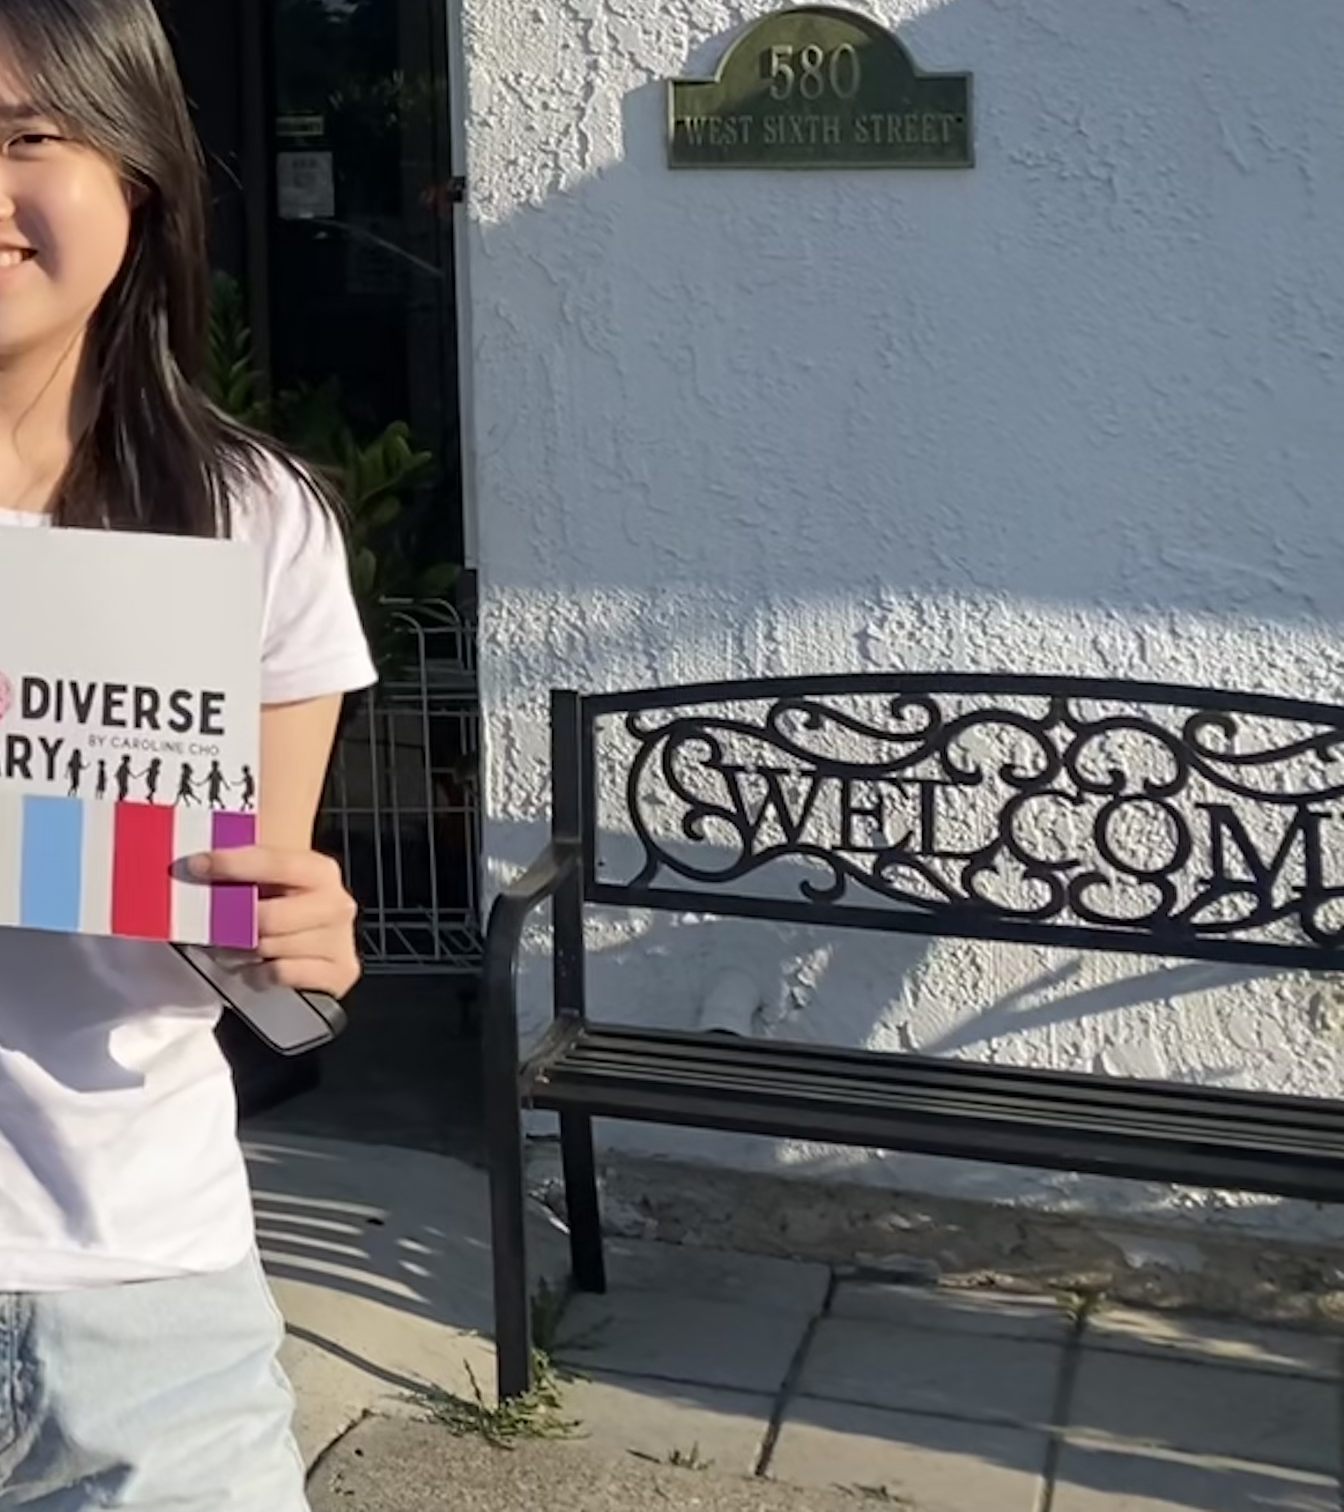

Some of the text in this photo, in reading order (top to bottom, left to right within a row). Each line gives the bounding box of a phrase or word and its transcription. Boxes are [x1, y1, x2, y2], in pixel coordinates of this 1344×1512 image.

[769, 44, 860, 100] 580
[683, 112, 955, 146] WEST SIXTH STREET
[88, 734, 219, 756] BY CAROLINE CHO
[722, 764, 1344, 910] WELCOM
